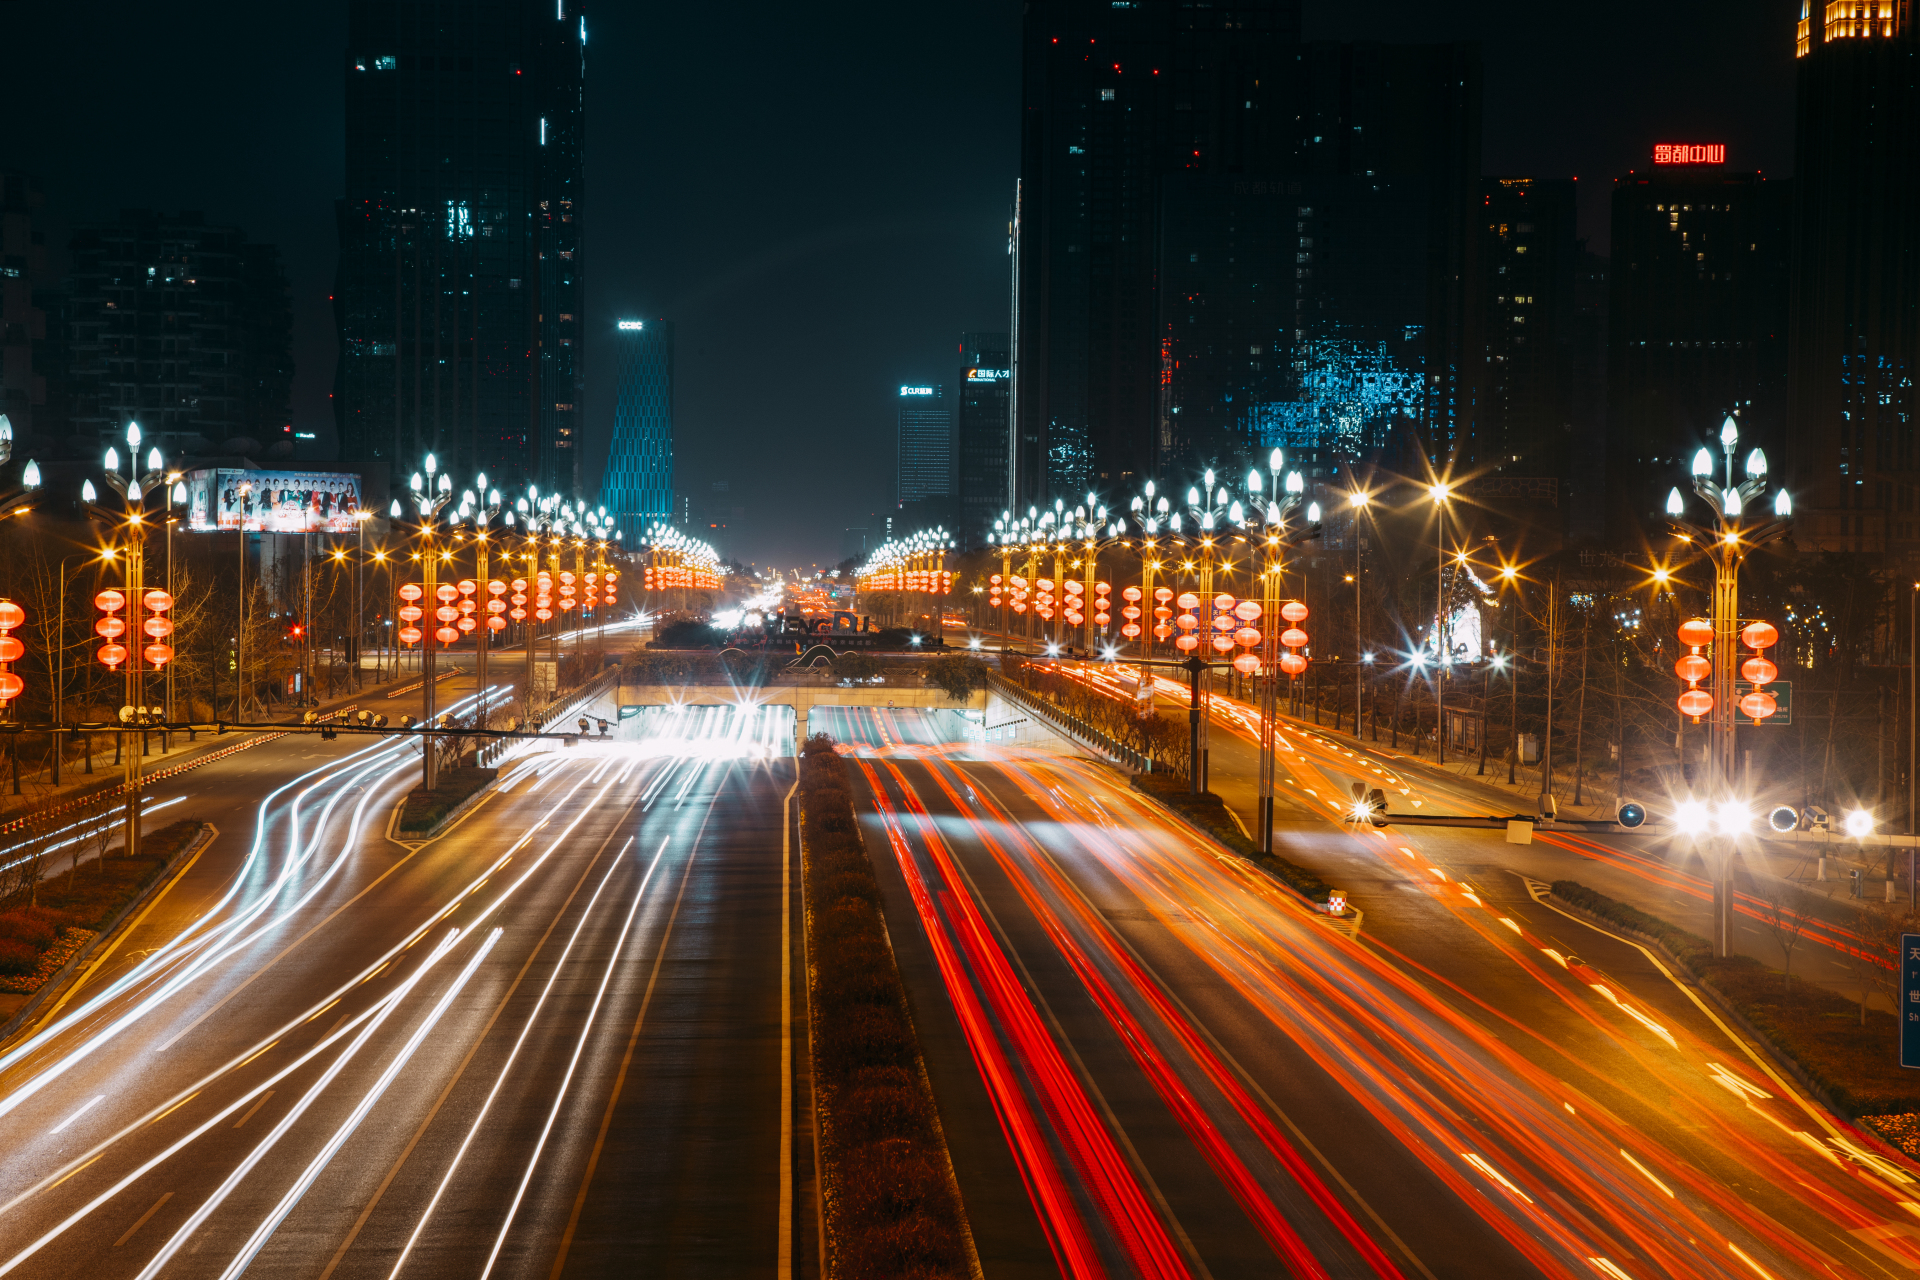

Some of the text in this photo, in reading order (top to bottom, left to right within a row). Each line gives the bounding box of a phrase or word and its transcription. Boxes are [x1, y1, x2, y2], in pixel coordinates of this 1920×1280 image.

[1655, 144, 1724, 163] 蜀都中心
[978, 370, 1009, 378] 国际人才
[1909, 947, 1920, 960] 天
[1909, 990, 1920, 1003] 世
